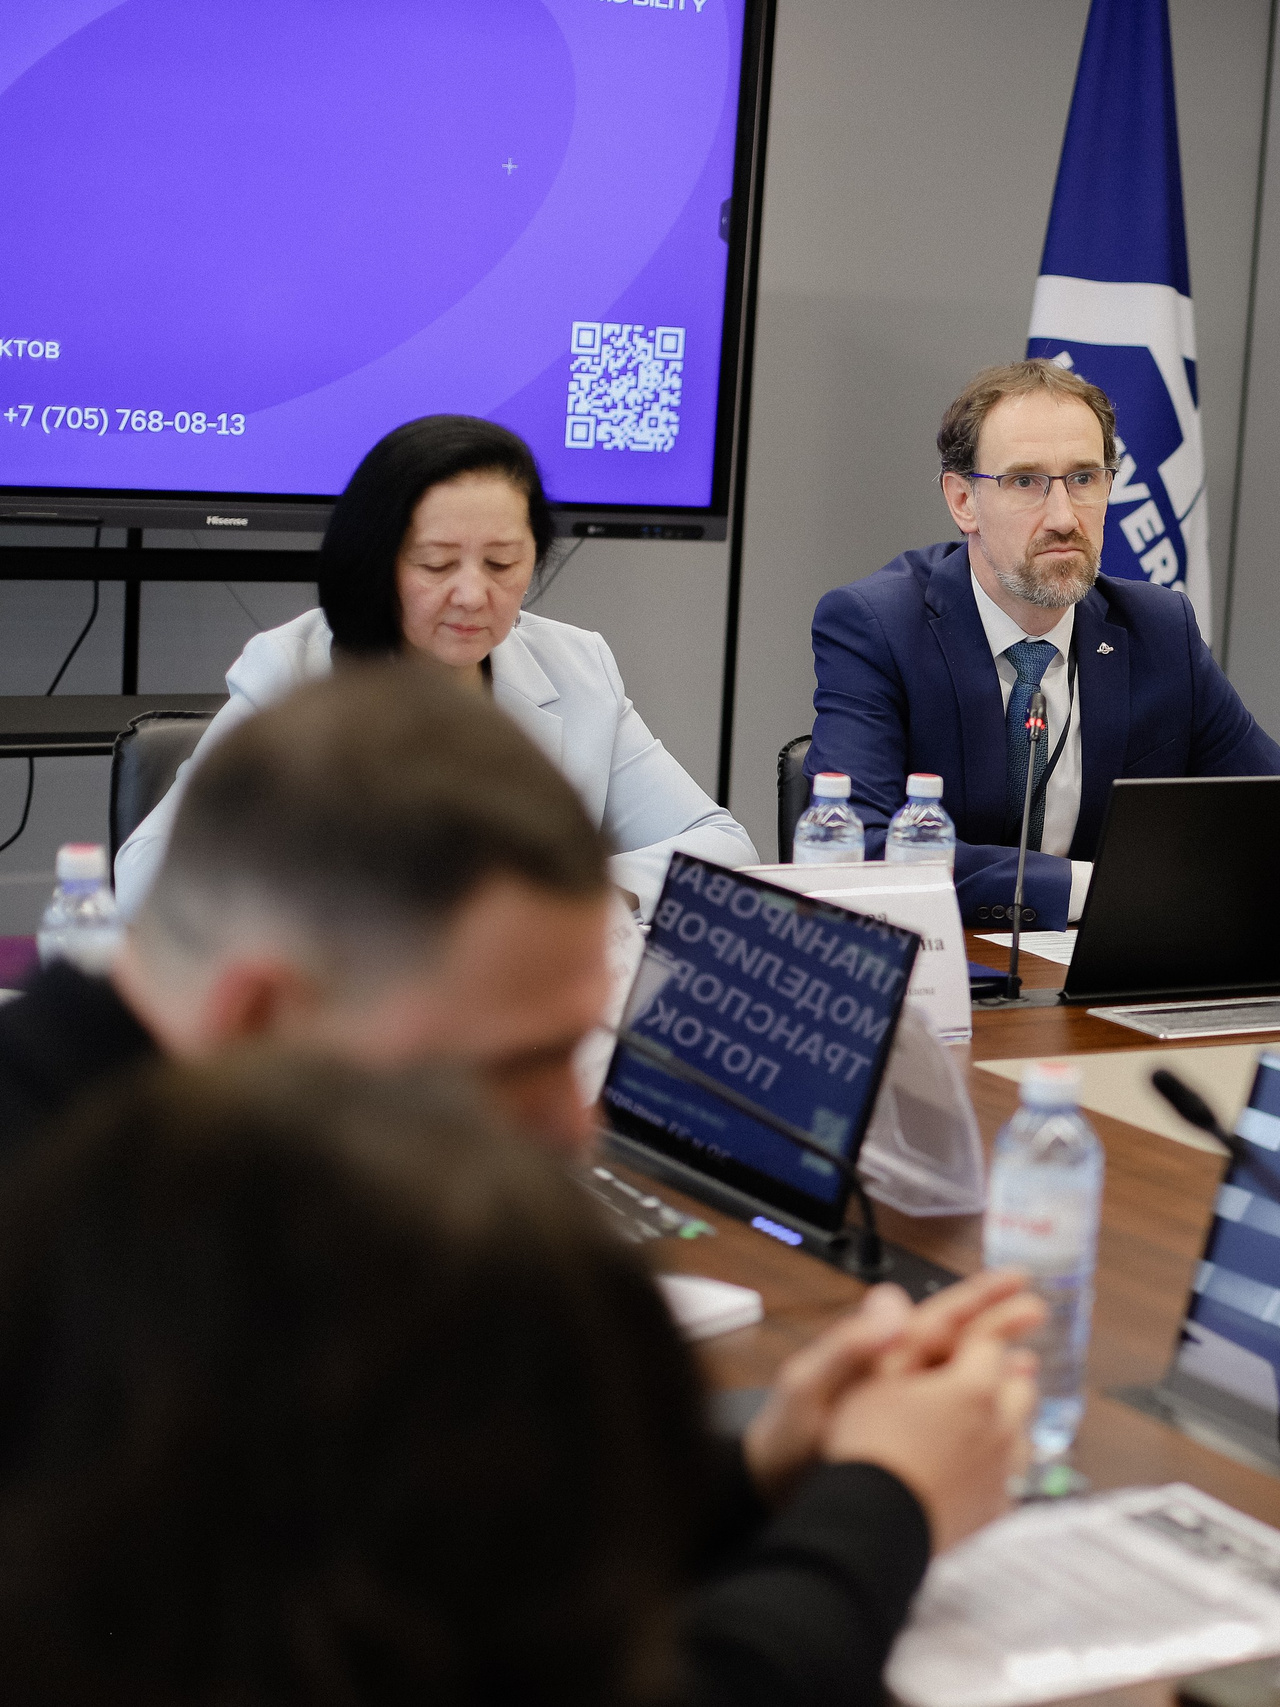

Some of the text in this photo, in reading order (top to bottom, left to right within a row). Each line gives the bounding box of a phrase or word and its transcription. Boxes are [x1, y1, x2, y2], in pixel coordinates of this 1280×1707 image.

[3, 404, 246, 436] +7 (705) 768-08-13
